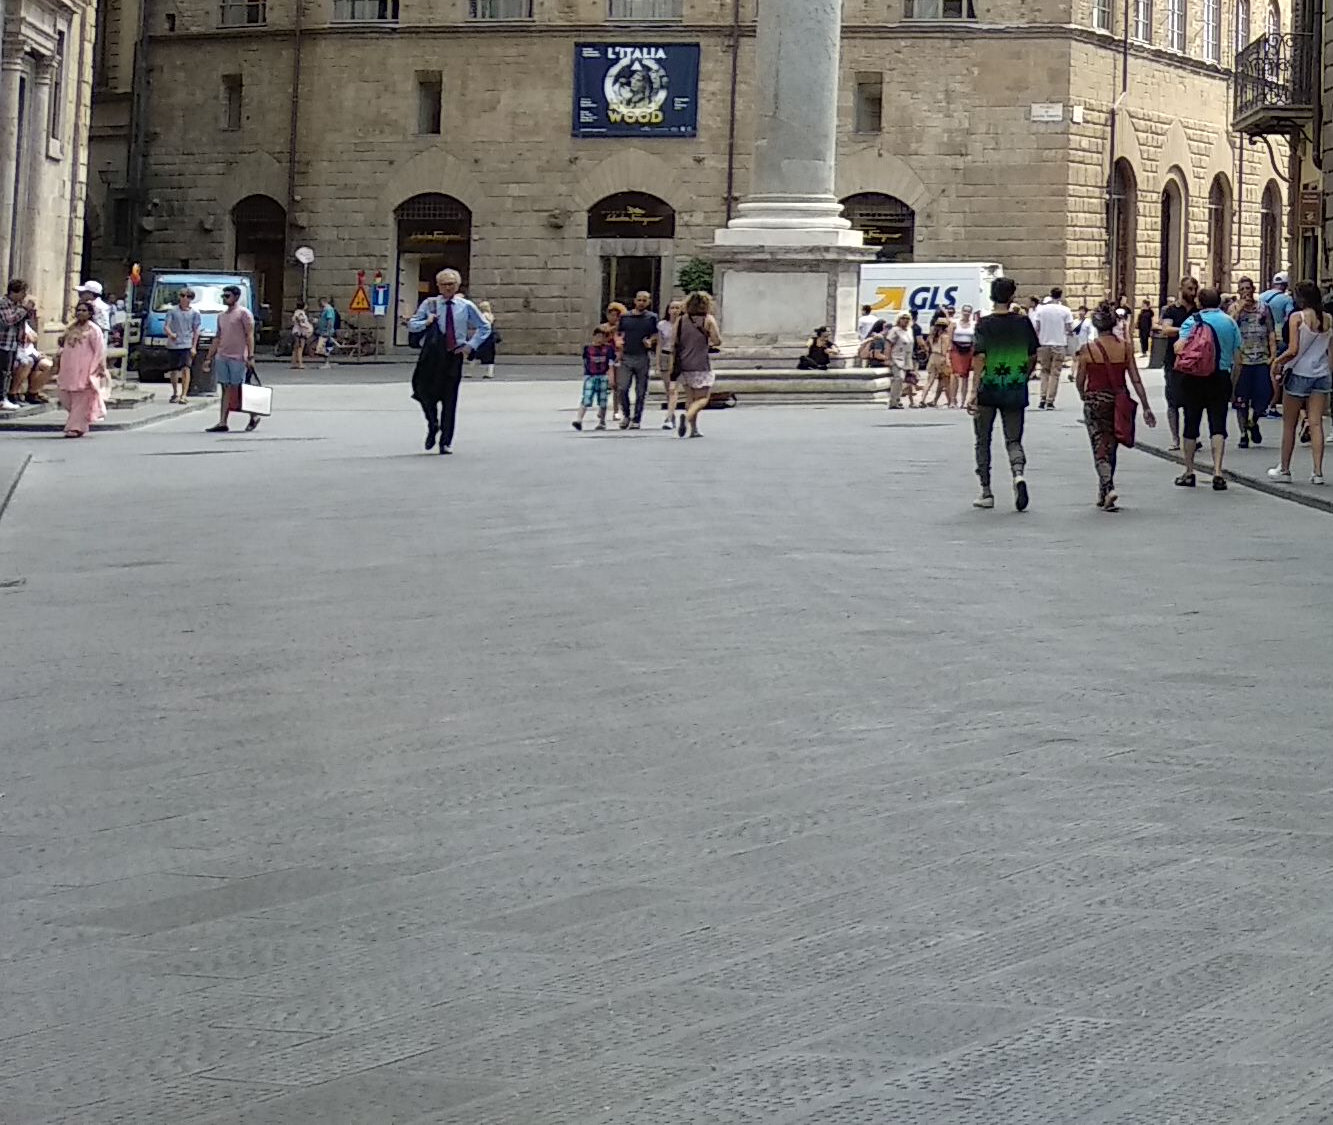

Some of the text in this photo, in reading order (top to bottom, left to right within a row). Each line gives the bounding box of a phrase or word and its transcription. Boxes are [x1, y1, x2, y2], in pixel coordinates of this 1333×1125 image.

[607, 46, 668, 60] L'ITALIA
[608, 110, 664, 124] WOOD
[908, 285, 959, 311] GLS
